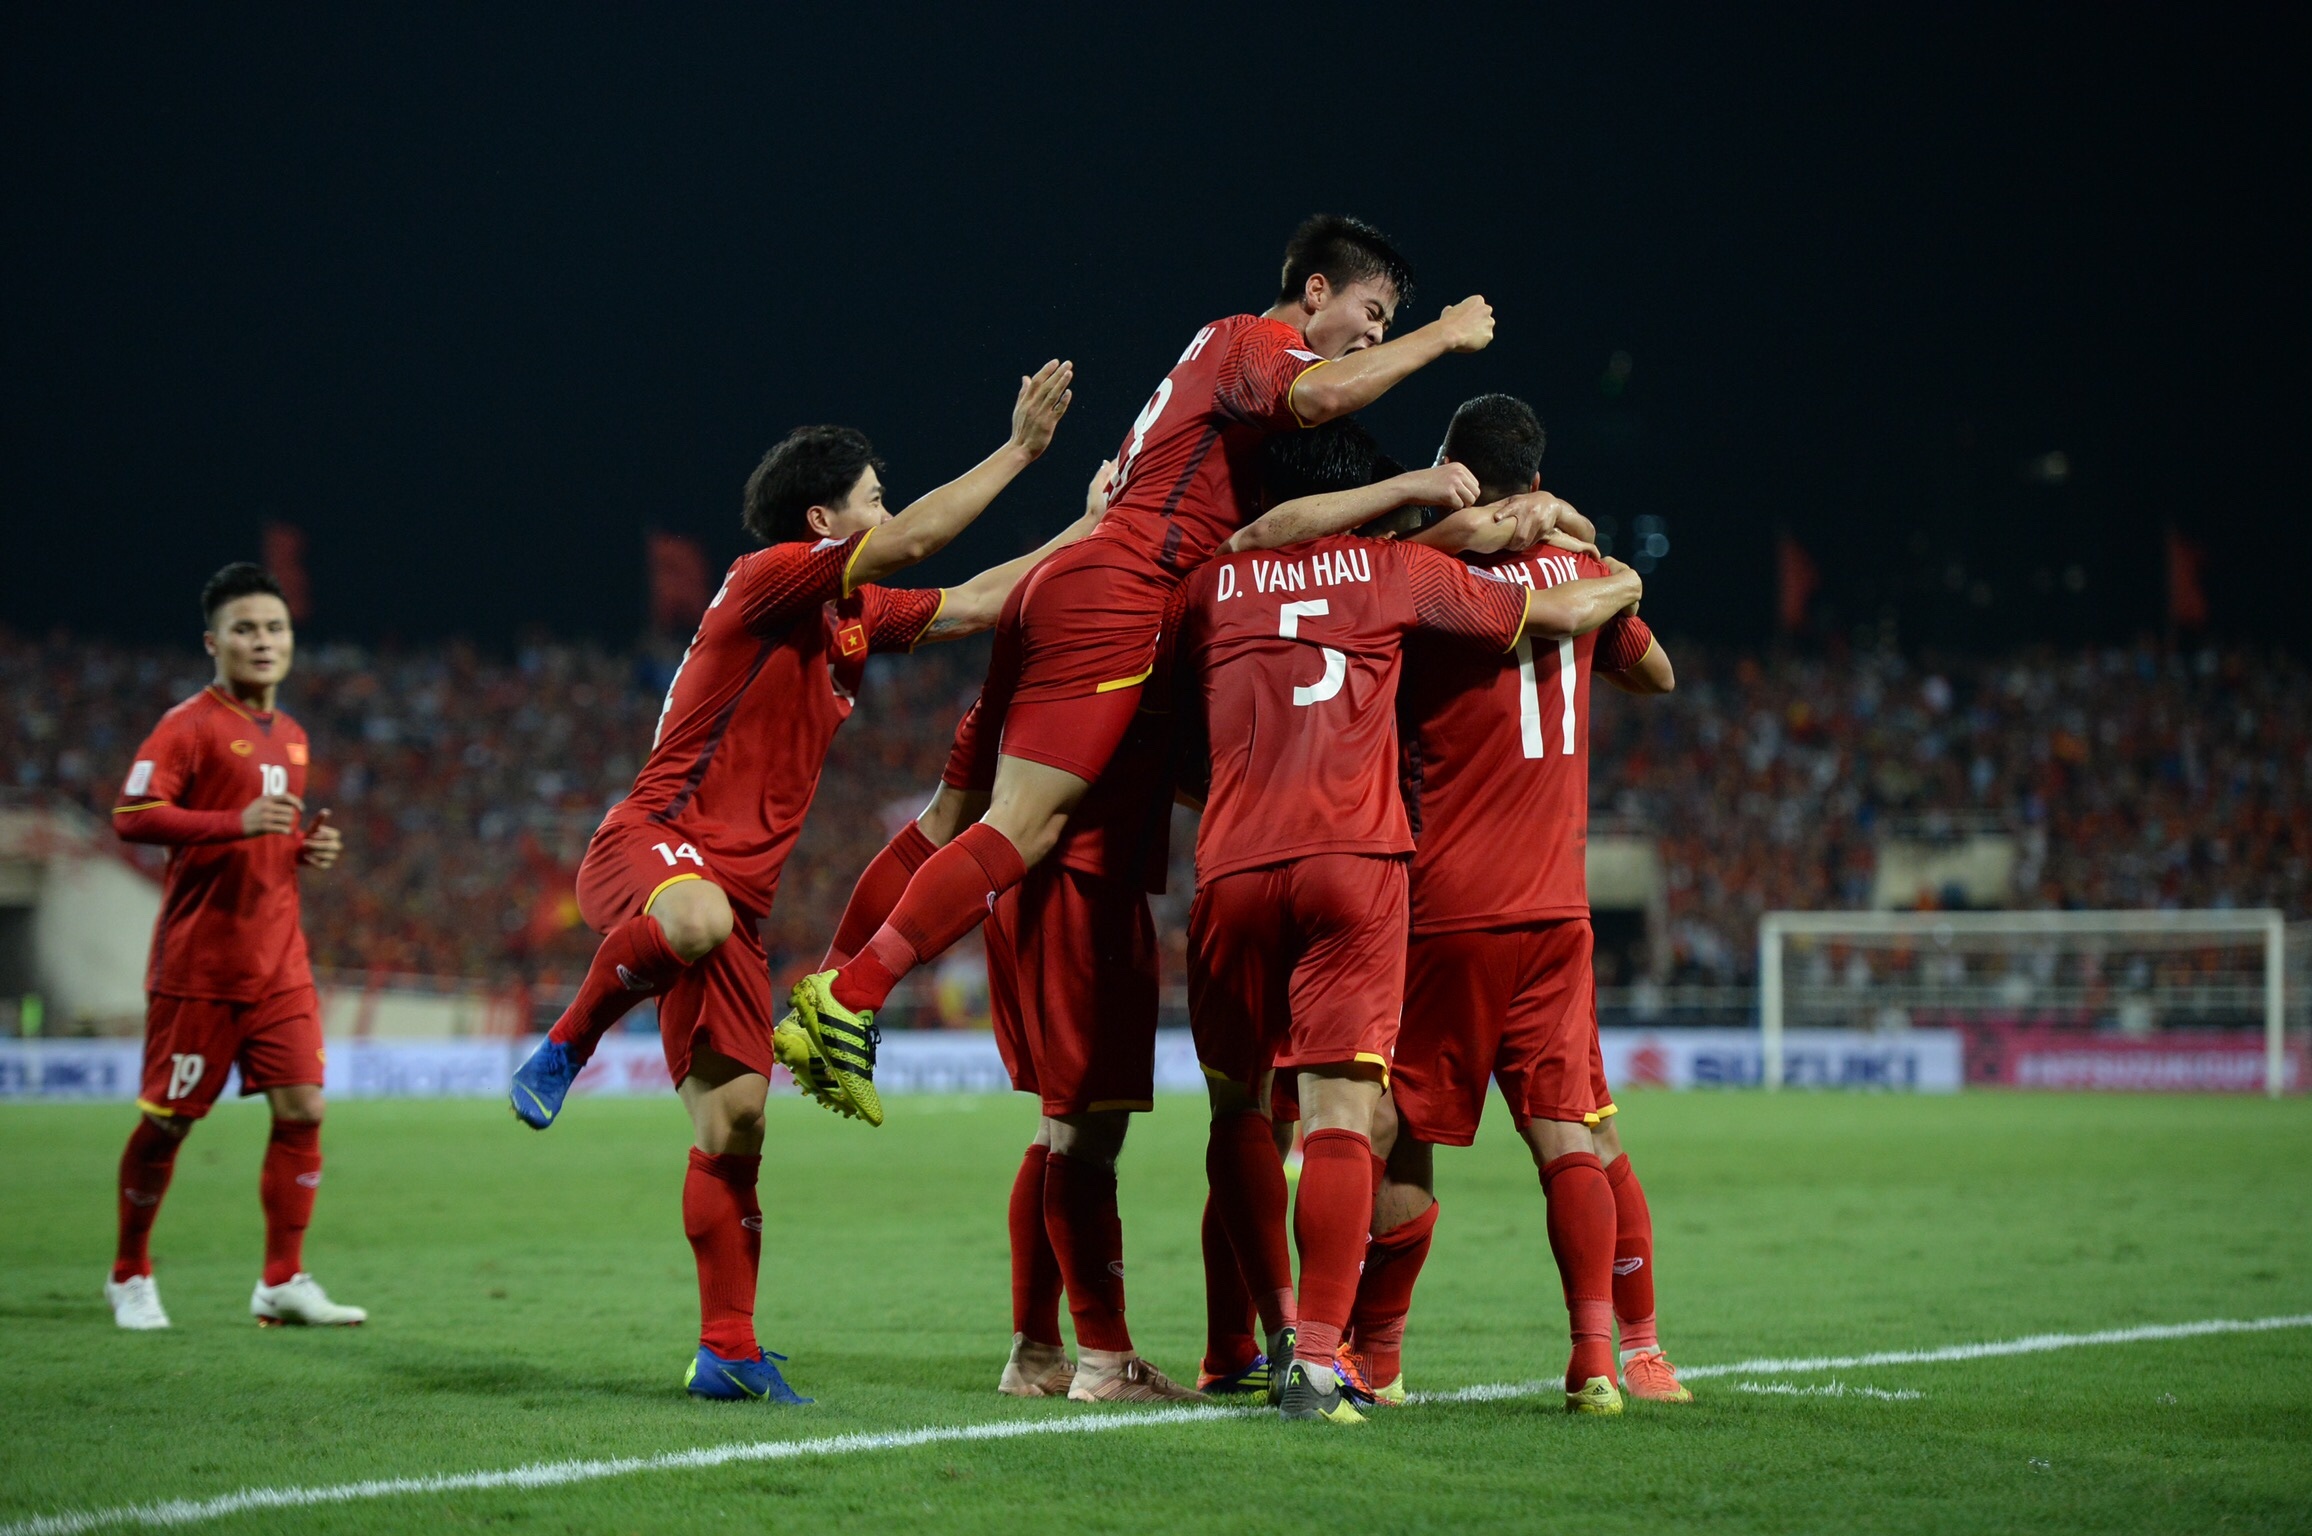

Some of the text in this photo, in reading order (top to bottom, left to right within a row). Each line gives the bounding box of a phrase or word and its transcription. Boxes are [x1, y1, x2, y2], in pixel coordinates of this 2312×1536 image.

[1217, 548, 1371, 602] D. VAN HAU
[1278, 598, 1347, 707] 5
[1515, 634, 1576, 759] 11
[651, 842, 704, 867] 14
[167, 1053, 206, 1100] 19
